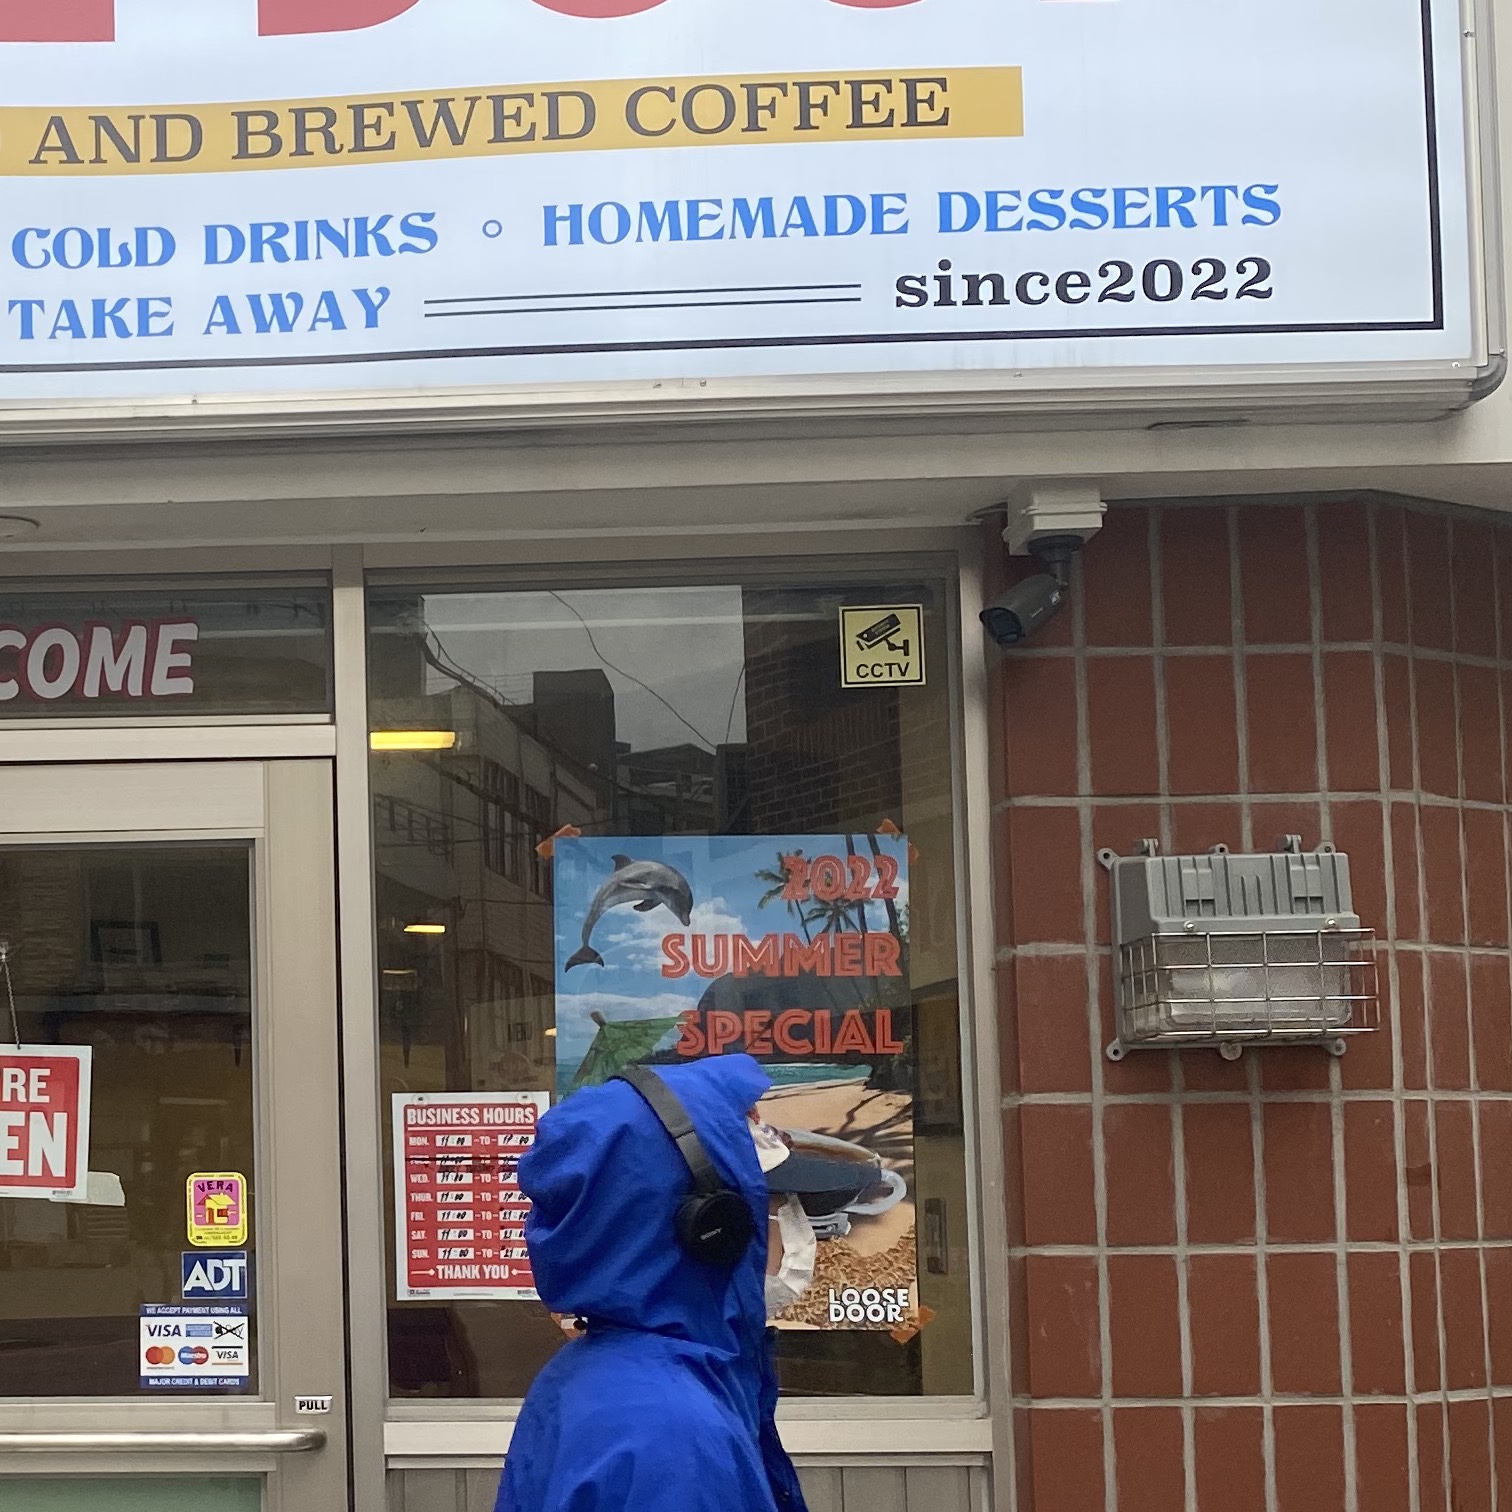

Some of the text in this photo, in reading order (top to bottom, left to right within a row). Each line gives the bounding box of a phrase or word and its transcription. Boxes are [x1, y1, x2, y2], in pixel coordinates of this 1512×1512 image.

[28, 114, 203, 164] AND
[231, 91, 596, 160] BREWED
[626, 77, 950, 139] COFFEE
[12, 226, 177, 270] COLD
[203, 211, 439, 265] DRINKS
[542, 193, 910, 247] HOMEMADE
[937, 184, 1282, 234] DESSERTS
[895, 257, 1274, 308] since2022
[7, 297, 175, 341] TAKE
[202, 286, 392, 337] AWAY
[856, 662, 910, 680] CCTV
[781, 854, 900, 900] 2022
[661, 932, 903, 979] SUMMER
[675, 1008, 904, 1057] SPECIAL
[407, 1107, 535, 1125] BUSINESS HOURS
[197, 1180, 233, 1193] VERA
[183, 1259, 246, 1291] ADT
[436, 1264, 509, 1279] THANK YOU
[828, 1287, 909, 1307] LOOSE
[157, 1306, 181, 1315] ACCEPT
[182, 1306, 209, 1315] PAYMENT
[210, 1306, 229, 1315] USING
[230, 1306, 242, 1315] ALL
[829, 1302, 904, 1324] DOOR
[147, 1324, 182, 1337] VISA
[216, 1350, 239, 1360] VISA
[148, 1378, 170, 1386] MAJOR
[171, 1378, 193, 1386] CREDIT
[218, 1378, 240, 1386] CARDS
[299, 1400, 327, 1410] PULL
